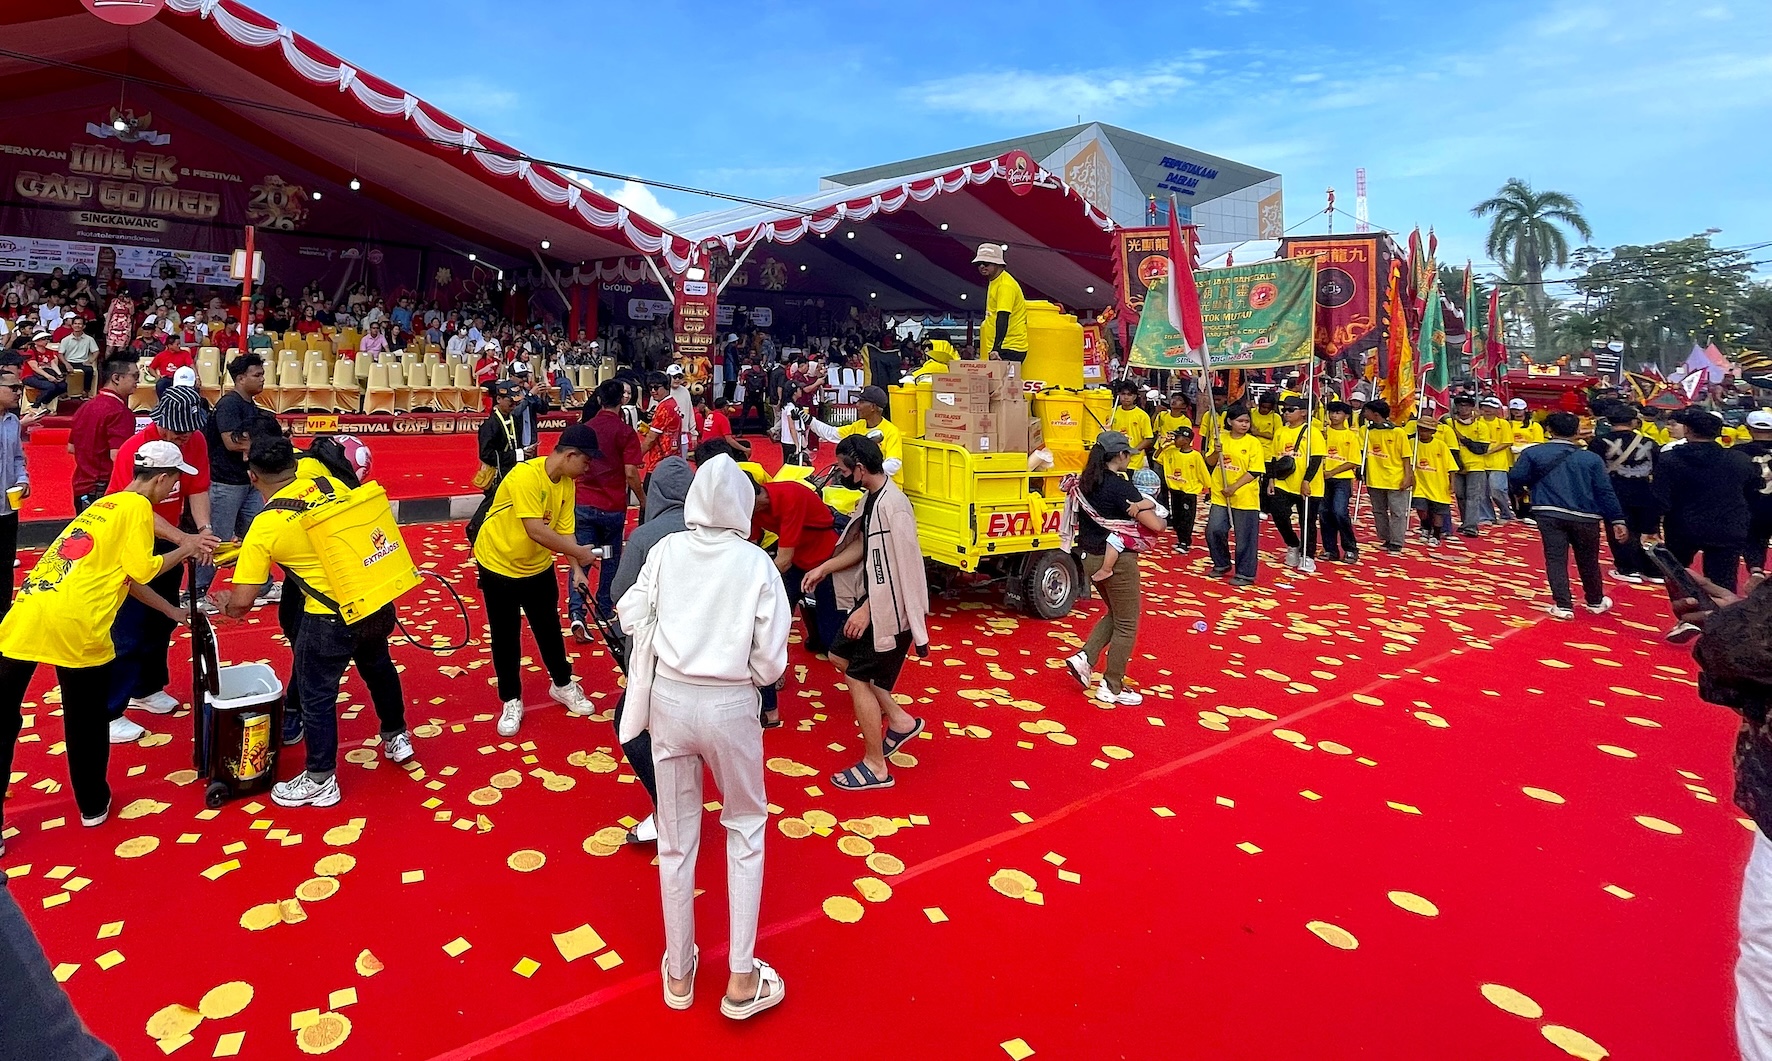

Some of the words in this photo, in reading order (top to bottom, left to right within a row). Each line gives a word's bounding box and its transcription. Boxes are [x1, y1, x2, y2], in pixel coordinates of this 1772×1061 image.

[69, 143, 179, 184] IMLEK
[193, 169, 243, 183] FESTIVAL
[1159, 156, 1219, 179] PERPUSTAKAAN
[1165, 172, 1199, 188] DAERAH
[15, 170, 93, 205] CAP
[99, 180, 147, 212] GO
[151, 186, 221, 218] MEH
[80, 213, 159, 228] SINGKAWANG
[602, 282, 633, 294] Group
[308, 420, 326, 428] VIP
[329, 419, 337, 428] A
[934, 412, 961, 420] EXTRAJOSS
[337, 423, 390, 433] FESTIVAL
[392, 417, 429, 434] CAP
[432, 417, 455, 434] GO
[457, 417, 487, 433] ME
[363, 541, 400, 567] EXTRAJOSS
[240, 727, 250, 776] EXTRAJOSS
